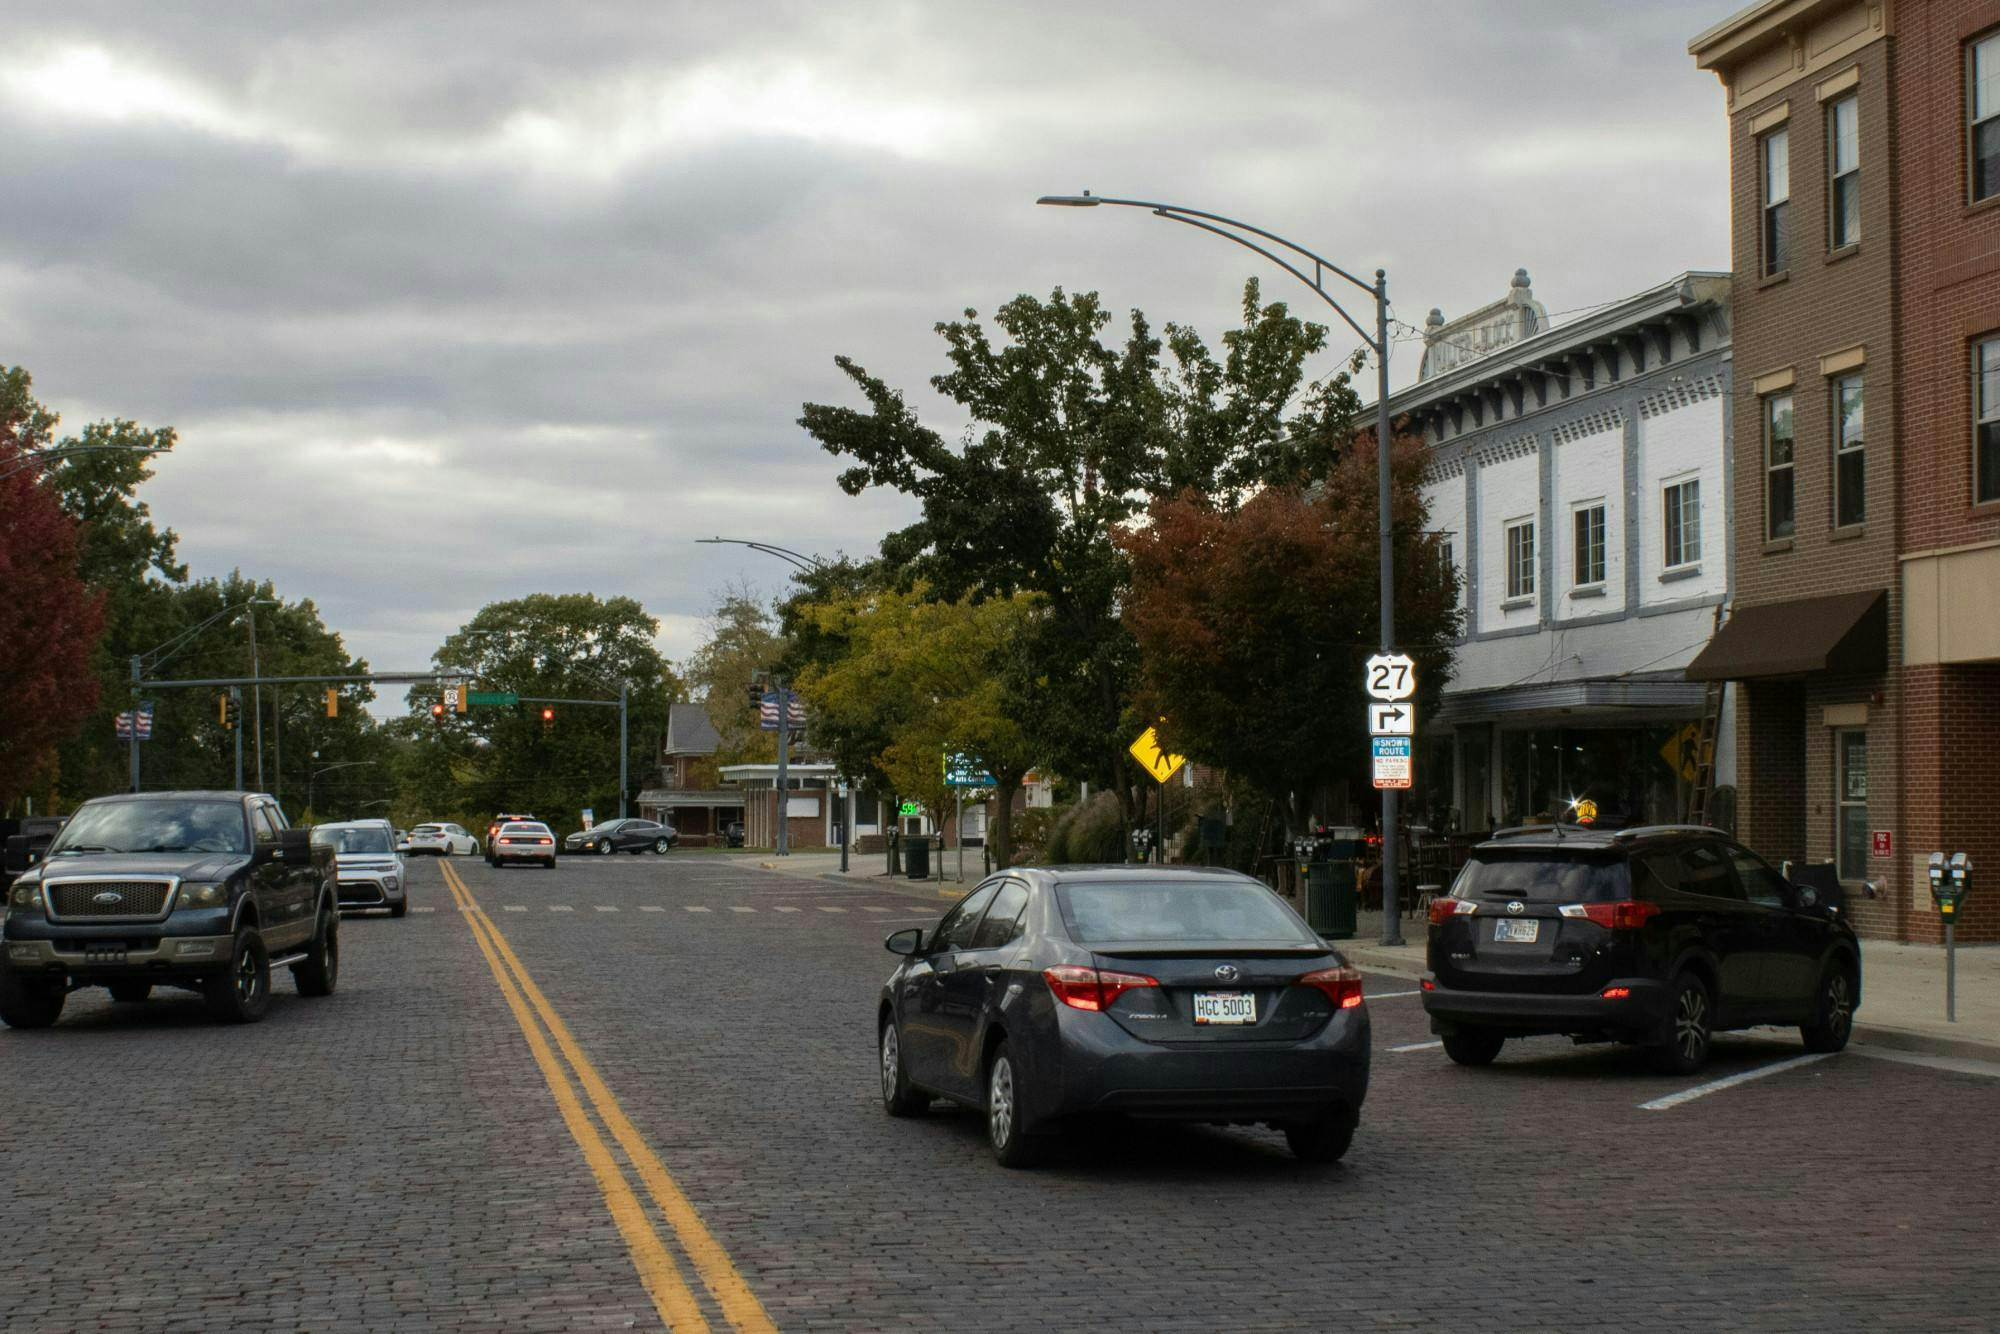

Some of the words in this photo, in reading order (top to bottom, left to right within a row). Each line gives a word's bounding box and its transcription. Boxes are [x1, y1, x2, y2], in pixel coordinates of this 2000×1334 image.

[1372, 665, 1408, 690] 27
[1380, 739, 1403, 747] SNOW
[1379, 747, 1405, 755] ROUTE
[1197, 999, 1220, 1016] HGC
[1222, 999, 1252, 1016] 5003
